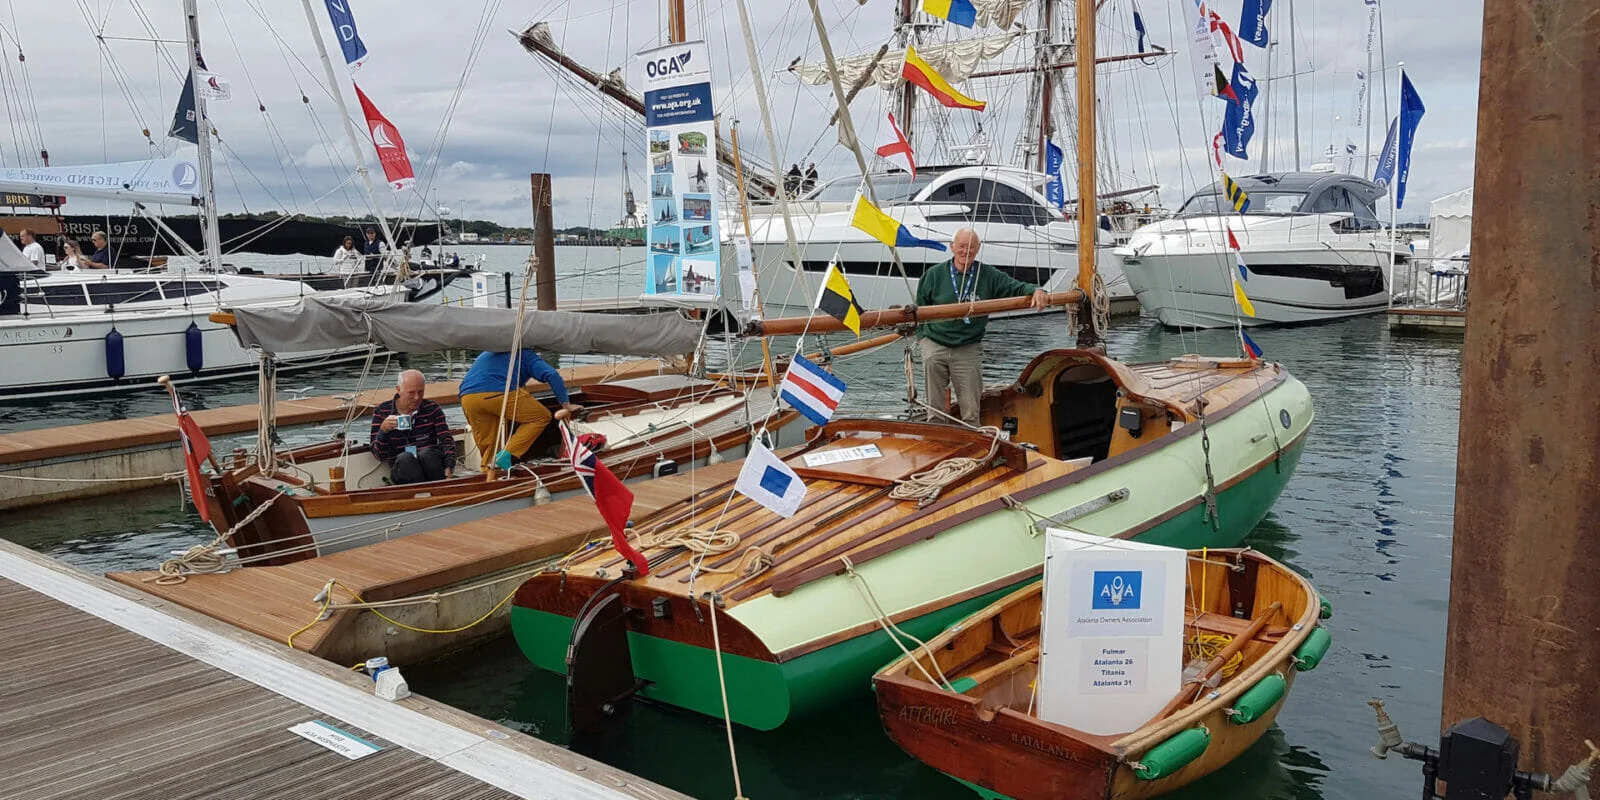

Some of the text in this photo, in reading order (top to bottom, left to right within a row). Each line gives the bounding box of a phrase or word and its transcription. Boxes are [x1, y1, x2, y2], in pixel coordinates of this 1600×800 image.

[646, 56, 680, 78] OGA
[59, 222, 138, 235] BRISE 1913
[52, 345, 63, 354] 33
[1101, 576, 1134, 597] AOA
[899, 704, 958, 729] ATTAGIRL
[1020, 734, 1078, 761] ATALANTA
